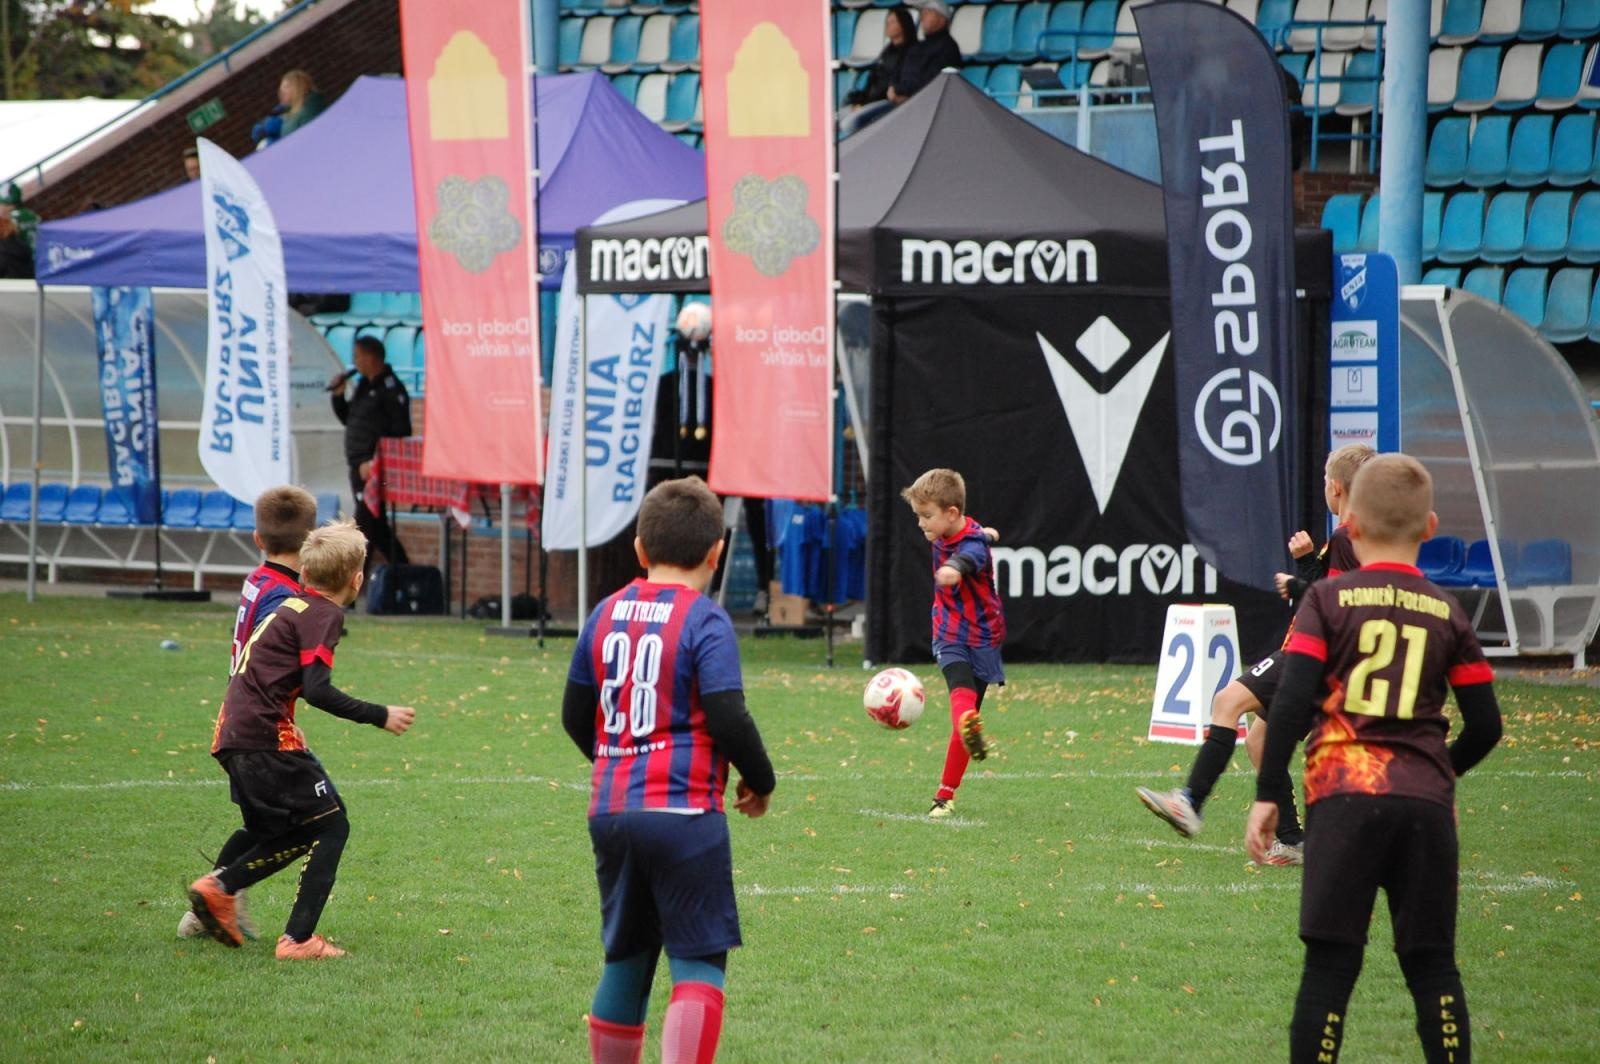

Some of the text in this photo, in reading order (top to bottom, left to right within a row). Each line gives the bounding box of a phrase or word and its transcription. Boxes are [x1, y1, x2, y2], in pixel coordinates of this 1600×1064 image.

[590, 236, 711, 282] macron
[901, 239, 1098, 284] macron
[561, 398, 576, 437] KLUB
[585, 354, 621, 467] UNIA
[612, 321, 656, 503] RACIBÓRZ
[555, 441, 570, 500] MIEJSKI
[990, 544, 1218, 598] macron
[601, 631, 663, 737] 28
[1162, 632, 1195, 715] 2
[1251, 657, 1275, 677] 9
[1344, 619, 1427, 719] 21
